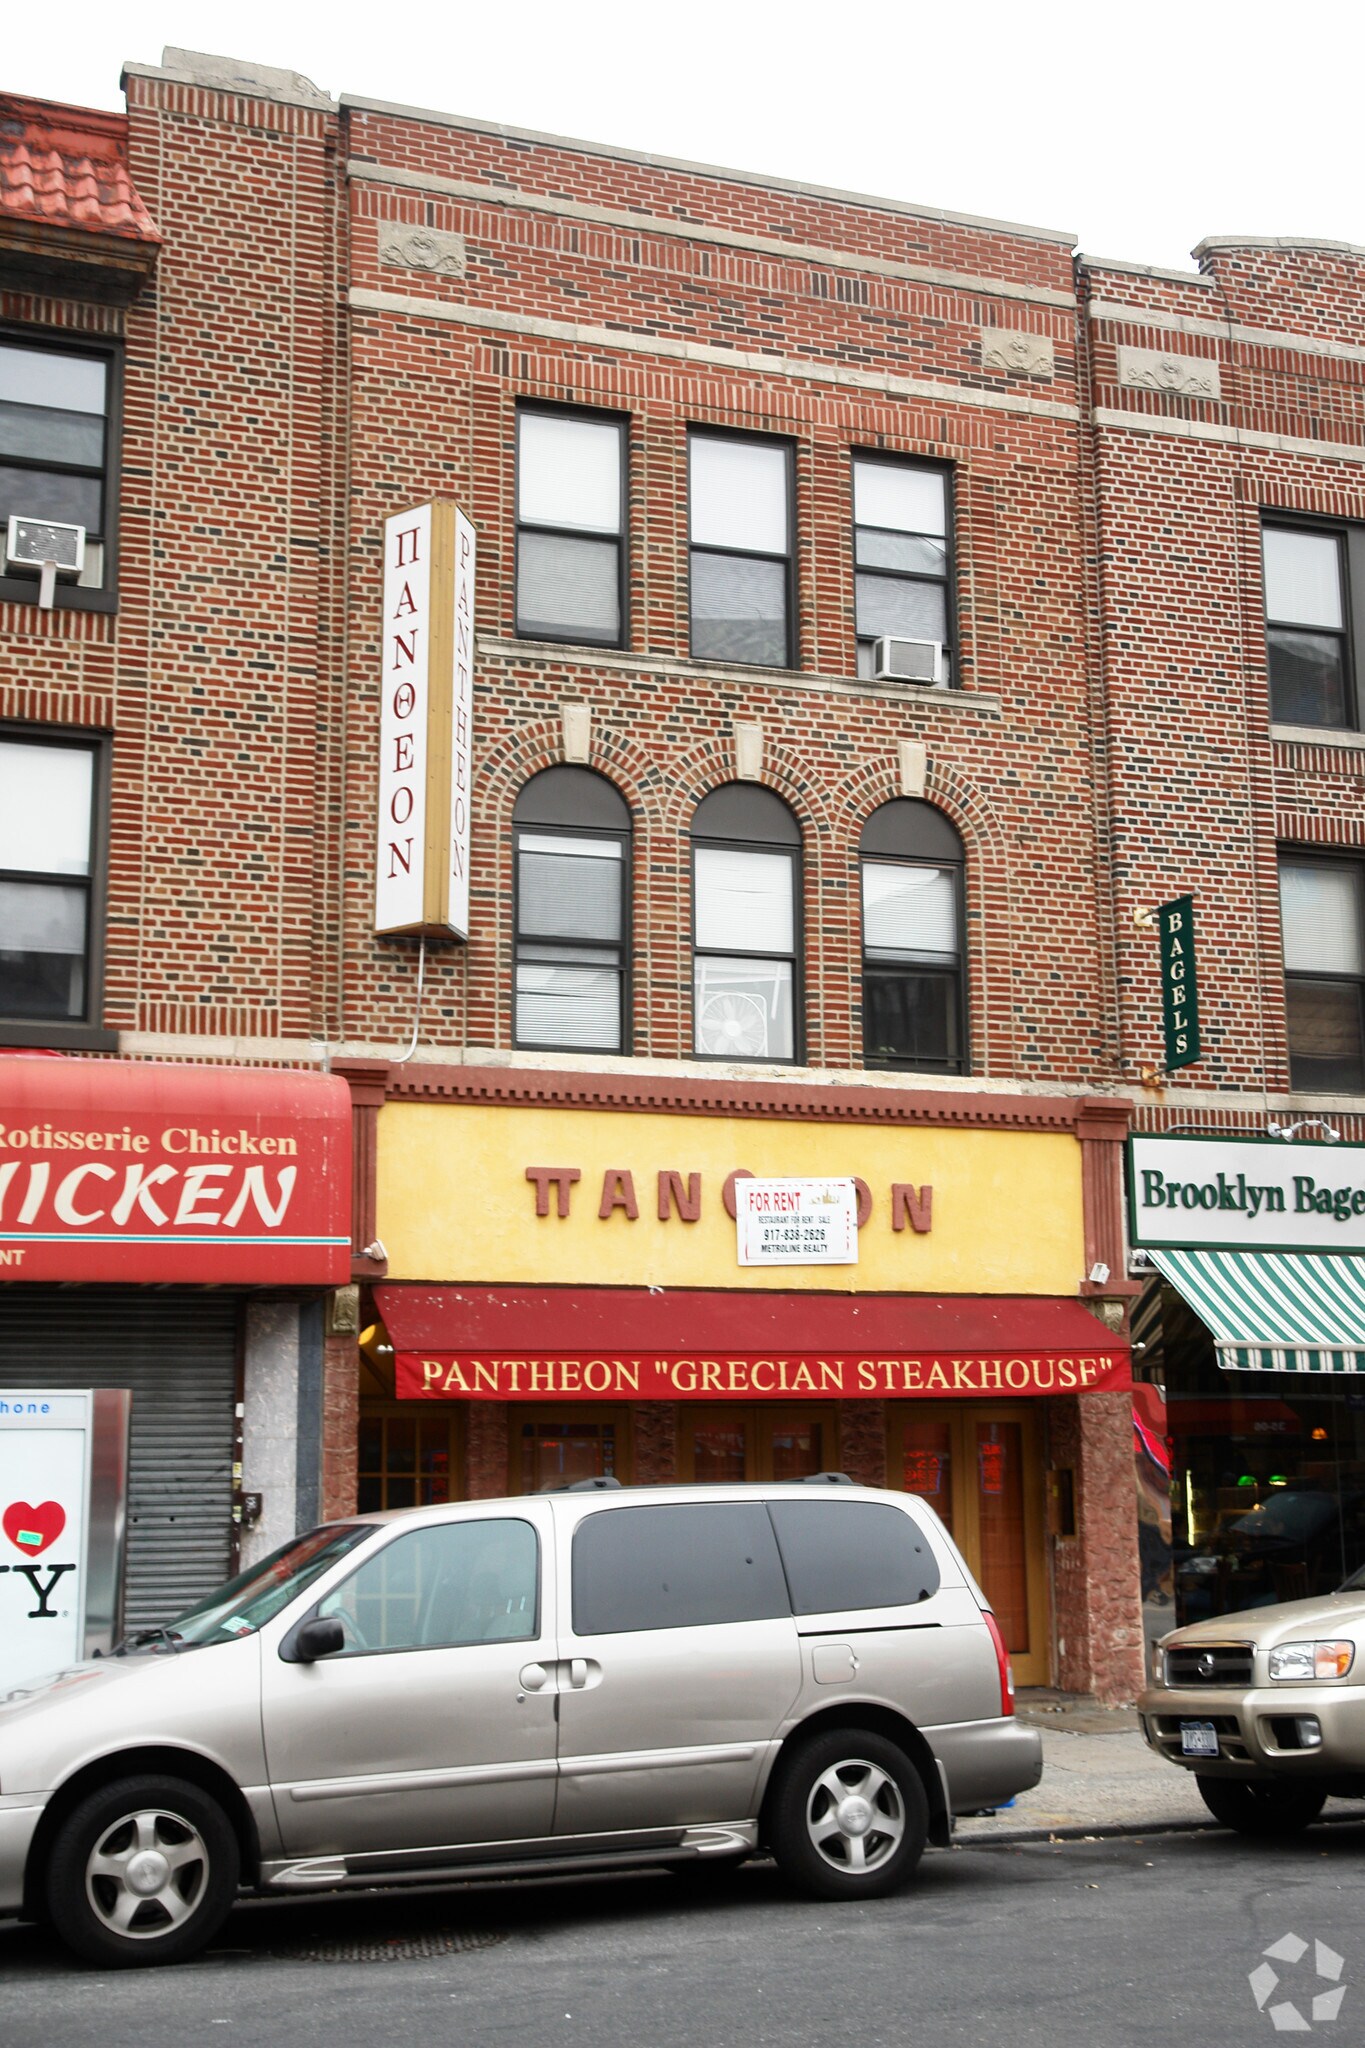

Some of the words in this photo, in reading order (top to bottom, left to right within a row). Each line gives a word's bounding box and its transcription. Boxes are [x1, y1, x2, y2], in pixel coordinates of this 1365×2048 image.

[453, 531, 471, 882] PANTHEON
[1168, 912, 1188, 1054] BAGELS
[161, 1128, 298, 1155] Chicken
[749, 1192, 770, 1211] FOR
[774, 1192, 801, 1211] RENT
[1140, 1169, 1286, 1218] Brooklyn
[1293, 1176, 1365, 1222] Bage
[758, 1216, 788, 1224] RESTAURANT
[791, 1216, 800, 1224] FOR
[802, 1216, 814, 1224] RENT
[818, 1216, 831, 1224] SALE
[761, 1244, 800, 1253] METROLINE
[803, 1244, 828, 1253] REALTY
[421, 1360, 641, 1391] PANTHEON
[654, 1359, 844, 1391] "GRECIAN
[858, 1357, 1112, 1391] STEAKHOUSE"
[0, 1563, 77, 1618] Y
